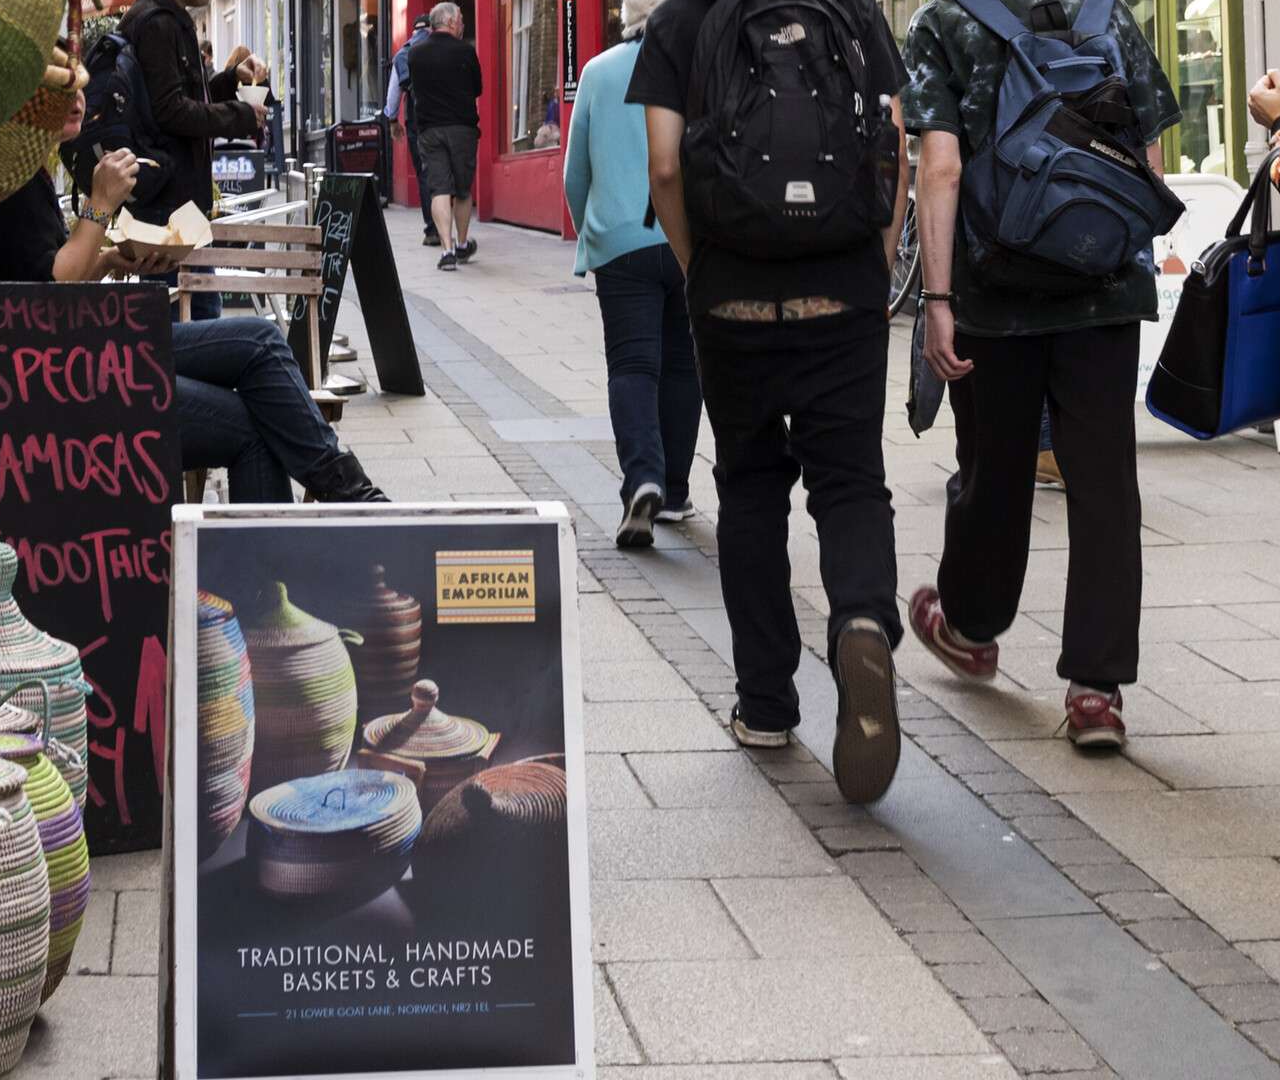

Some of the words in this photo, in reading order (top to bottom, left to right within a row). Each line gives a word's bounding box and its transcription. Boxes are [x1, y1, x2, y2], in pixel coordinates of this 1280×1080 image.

[458, 572, 529, 584] AFRICAN
[442, 587, 529, 600] EMPORIUM
[237, 943, 395, 968] TRADITIONAL,
[406, 938, 535, 962] HANDMADE
[283, 970, 376, 993] BASKETS
[386, 969, 400, 989] &
[410, 965, 492, 988] CRAFTS
[286, 1009, 297, 1019] 21
[300, 1007, 335, 1018] LOWER
[336, 1006, 365, 1017] GOAT
[397, 1003, 449, 1015] NORWICH,
[452, 1002, 471, 1013] NR2
[474, 1001, 490, 1012] 1EL
